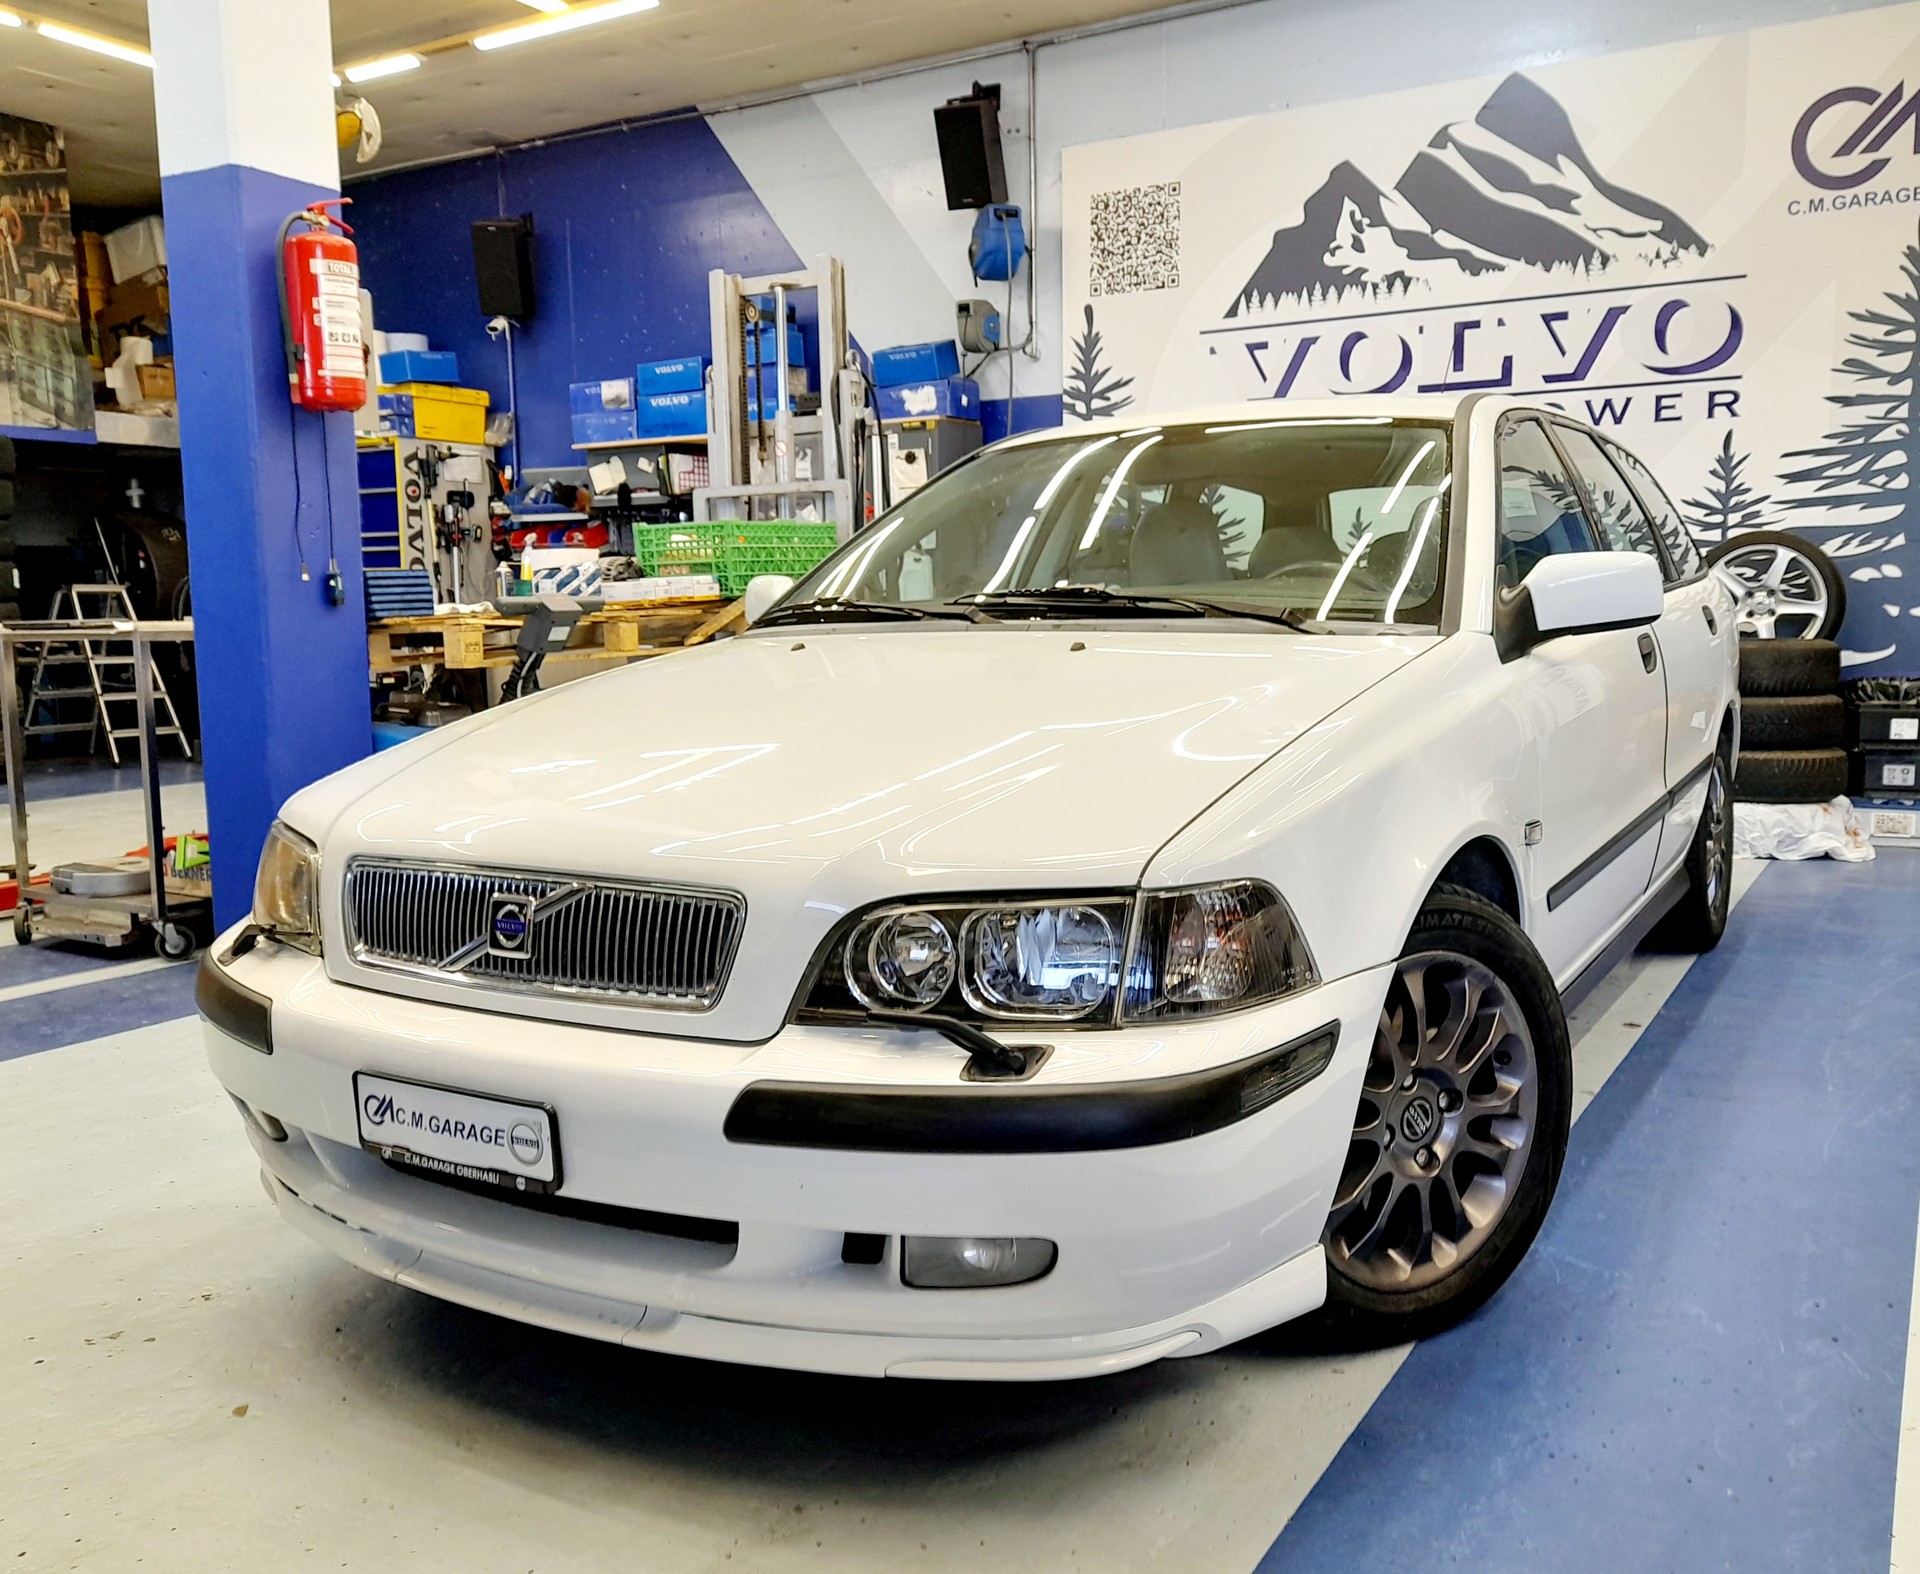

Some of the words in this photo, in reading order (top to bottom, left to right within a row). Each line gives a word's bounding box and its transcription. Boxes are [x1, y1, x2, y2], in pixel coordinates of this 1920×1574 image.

[328, 261, 353, 274] TOTAL
[1209, 297, 1744, 401] VOLVO
[888, 351, 917, 361] VOLVO
[654, 363, 684, 375] VOLVO
[584, 385, 601, 396] VOL
[649, 394, 690, 408] VOLVO
[1545, 389, 1742, 427] WER
[496, 921, 523, 931] VOLVO
[395, 1107, 506, 1148] C.M.GARAGE
[404, 1152, 456, 1175] C.M.GARAGE
[456, 1164, 500, 1185] OBERHASLI
